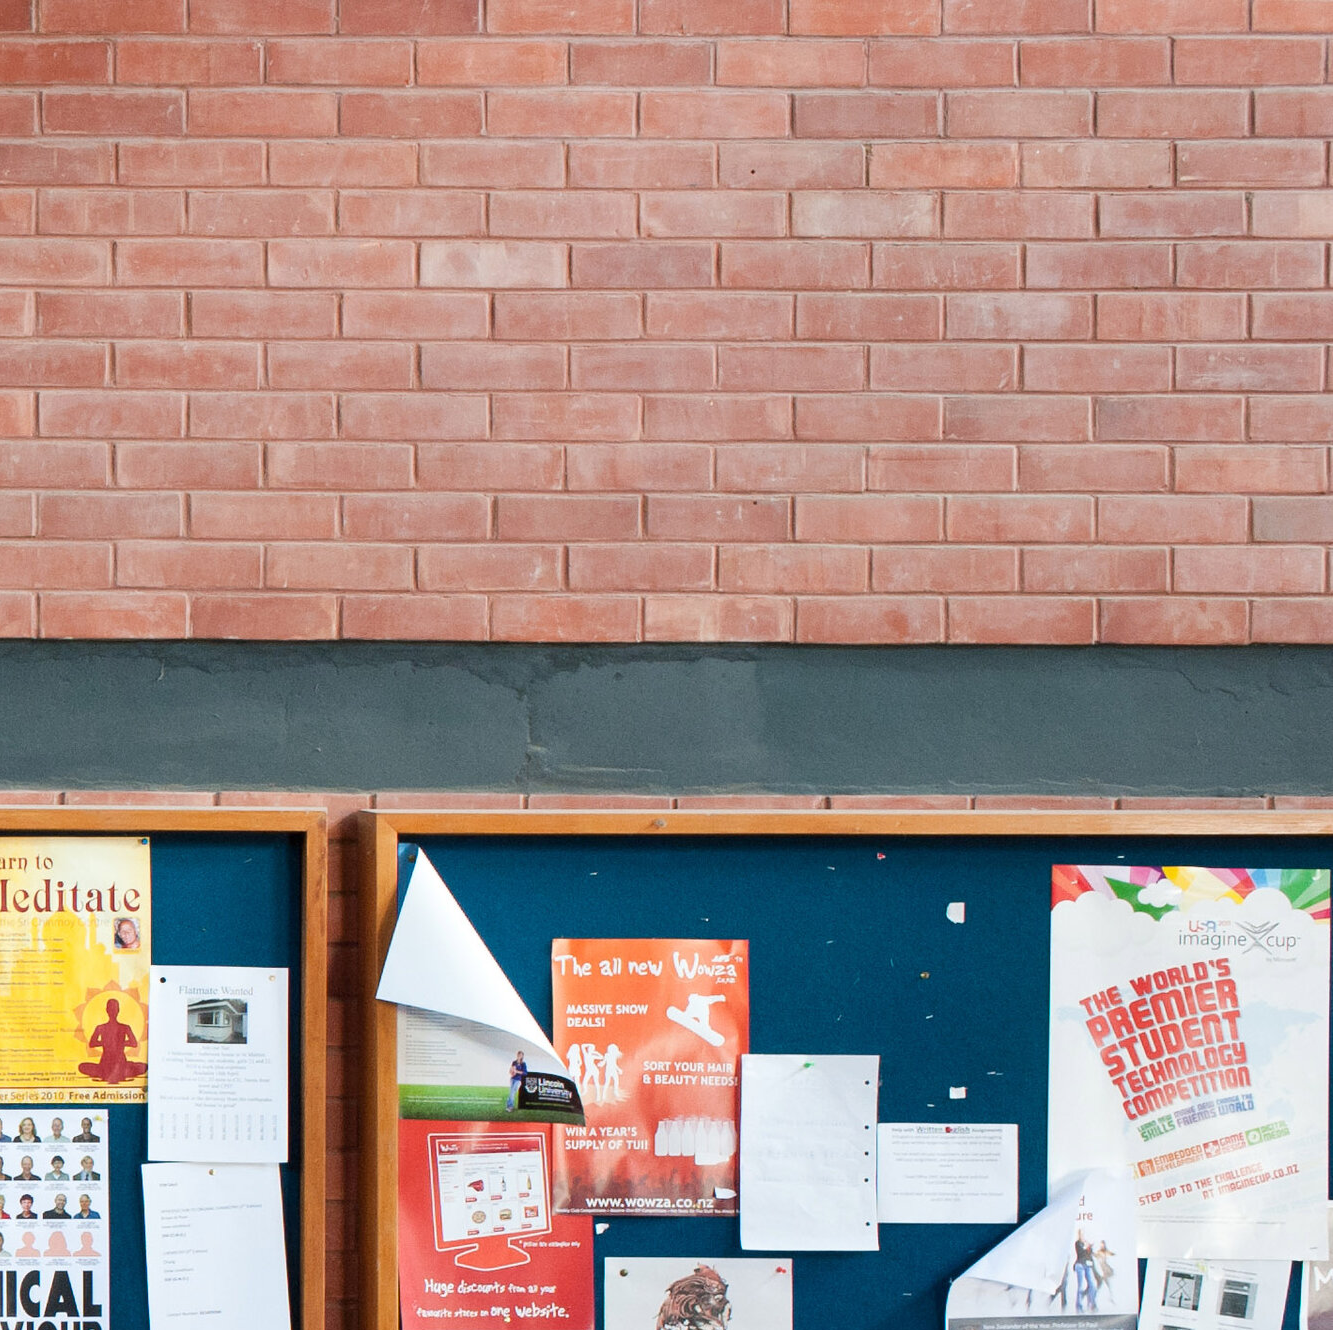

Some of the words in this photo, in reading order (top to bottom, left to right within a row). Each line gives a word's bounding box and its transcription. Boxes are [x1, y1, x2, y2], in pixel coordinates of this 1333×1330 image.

[35, 854, 54, 870] to
[1178, 931, 1247, 951] imagine
[1079, 985, 1122, 1015] THE
[1129, 957, 1231, 998] WORLD'S
[1085, 978, 1238, 1047] PREMIER
[1100, 1010, 1242, 1078] STUDENT
[1112, 1042, 1248, 1099] TECHNOLOGY
[10, 1090, 39, 1101] Series
[41, 1091, 64, 1101] 2010
[68, 1091, 91, 1100] Free
[92, 1090, 145, 1100] Admission
[1122, 1066, 1252, 1121] COMPETITION
